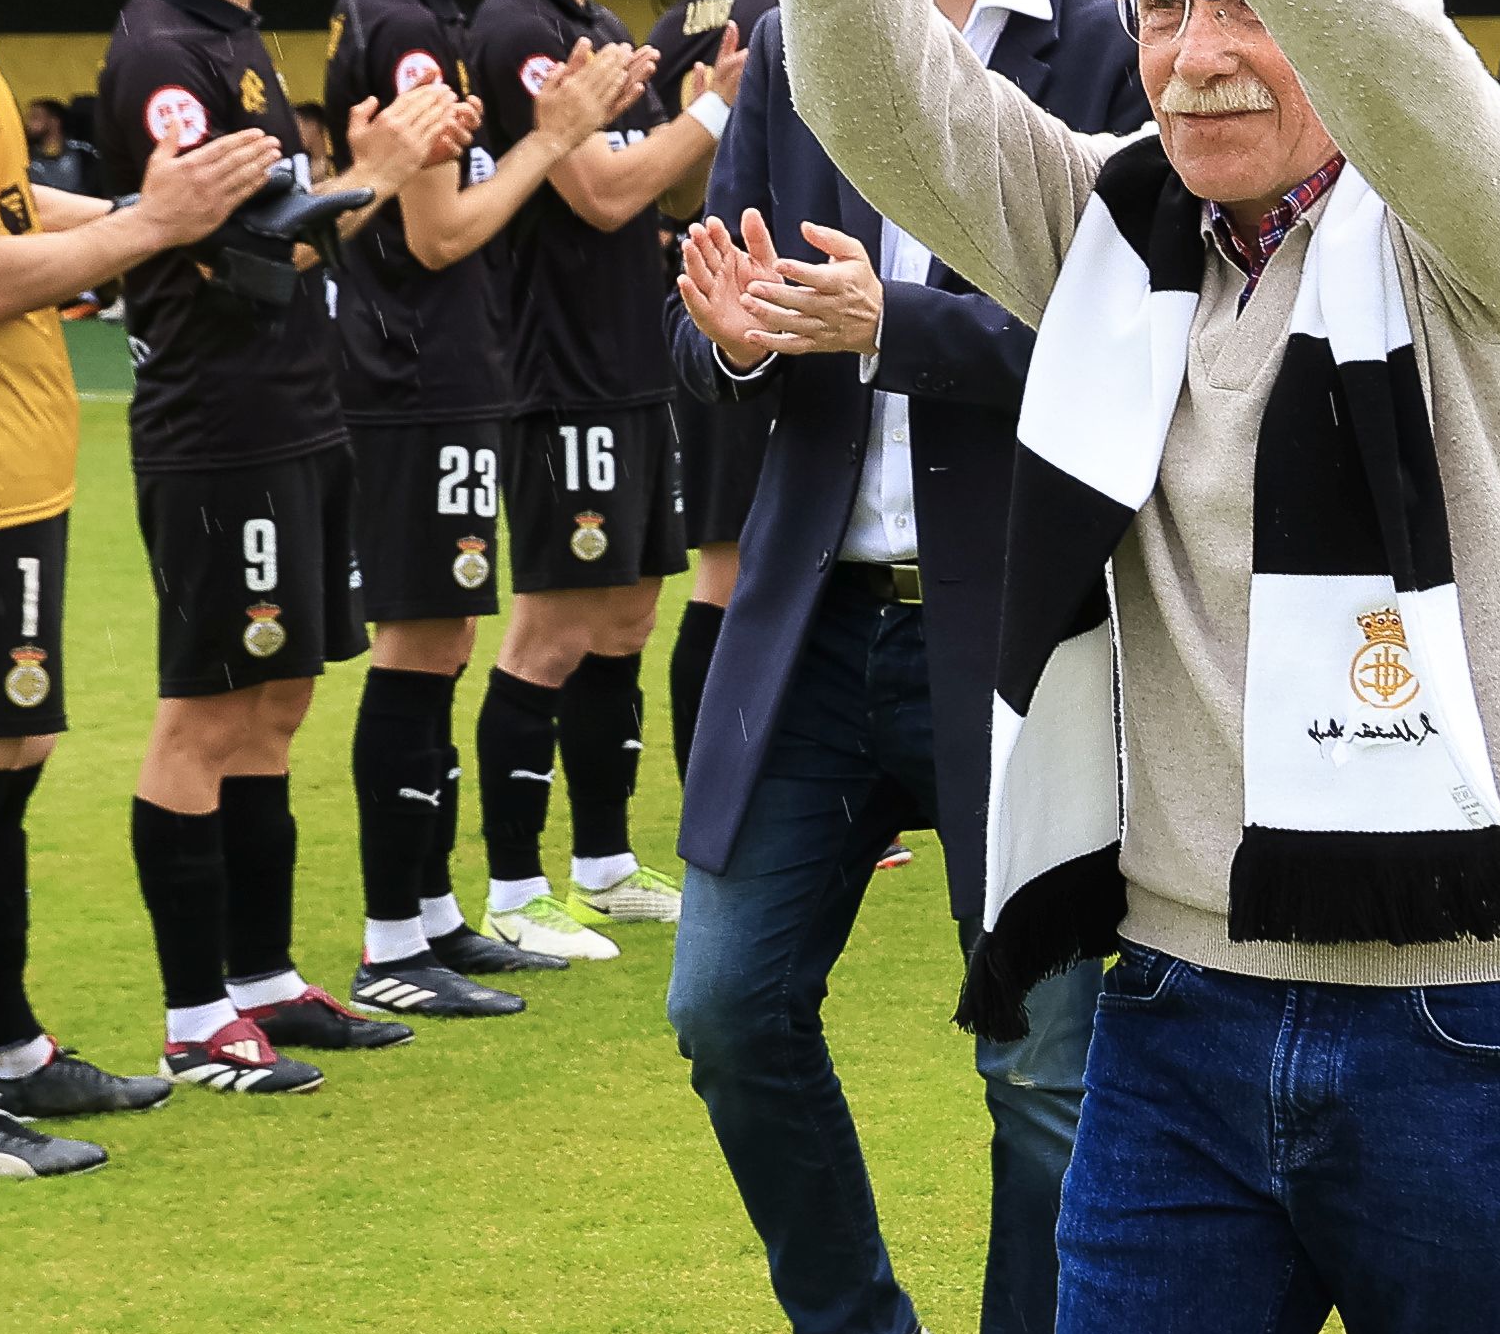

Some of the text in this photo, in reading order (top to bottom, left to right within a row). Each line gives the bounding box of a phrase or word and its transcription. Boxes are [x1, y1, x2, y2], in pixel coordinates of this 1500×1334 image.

[437, 445, 498, 517] 23
[559, 425, 616, 492] 16
[243, 518, 278, 592] 9
[17, 557, 41, 637] 1
